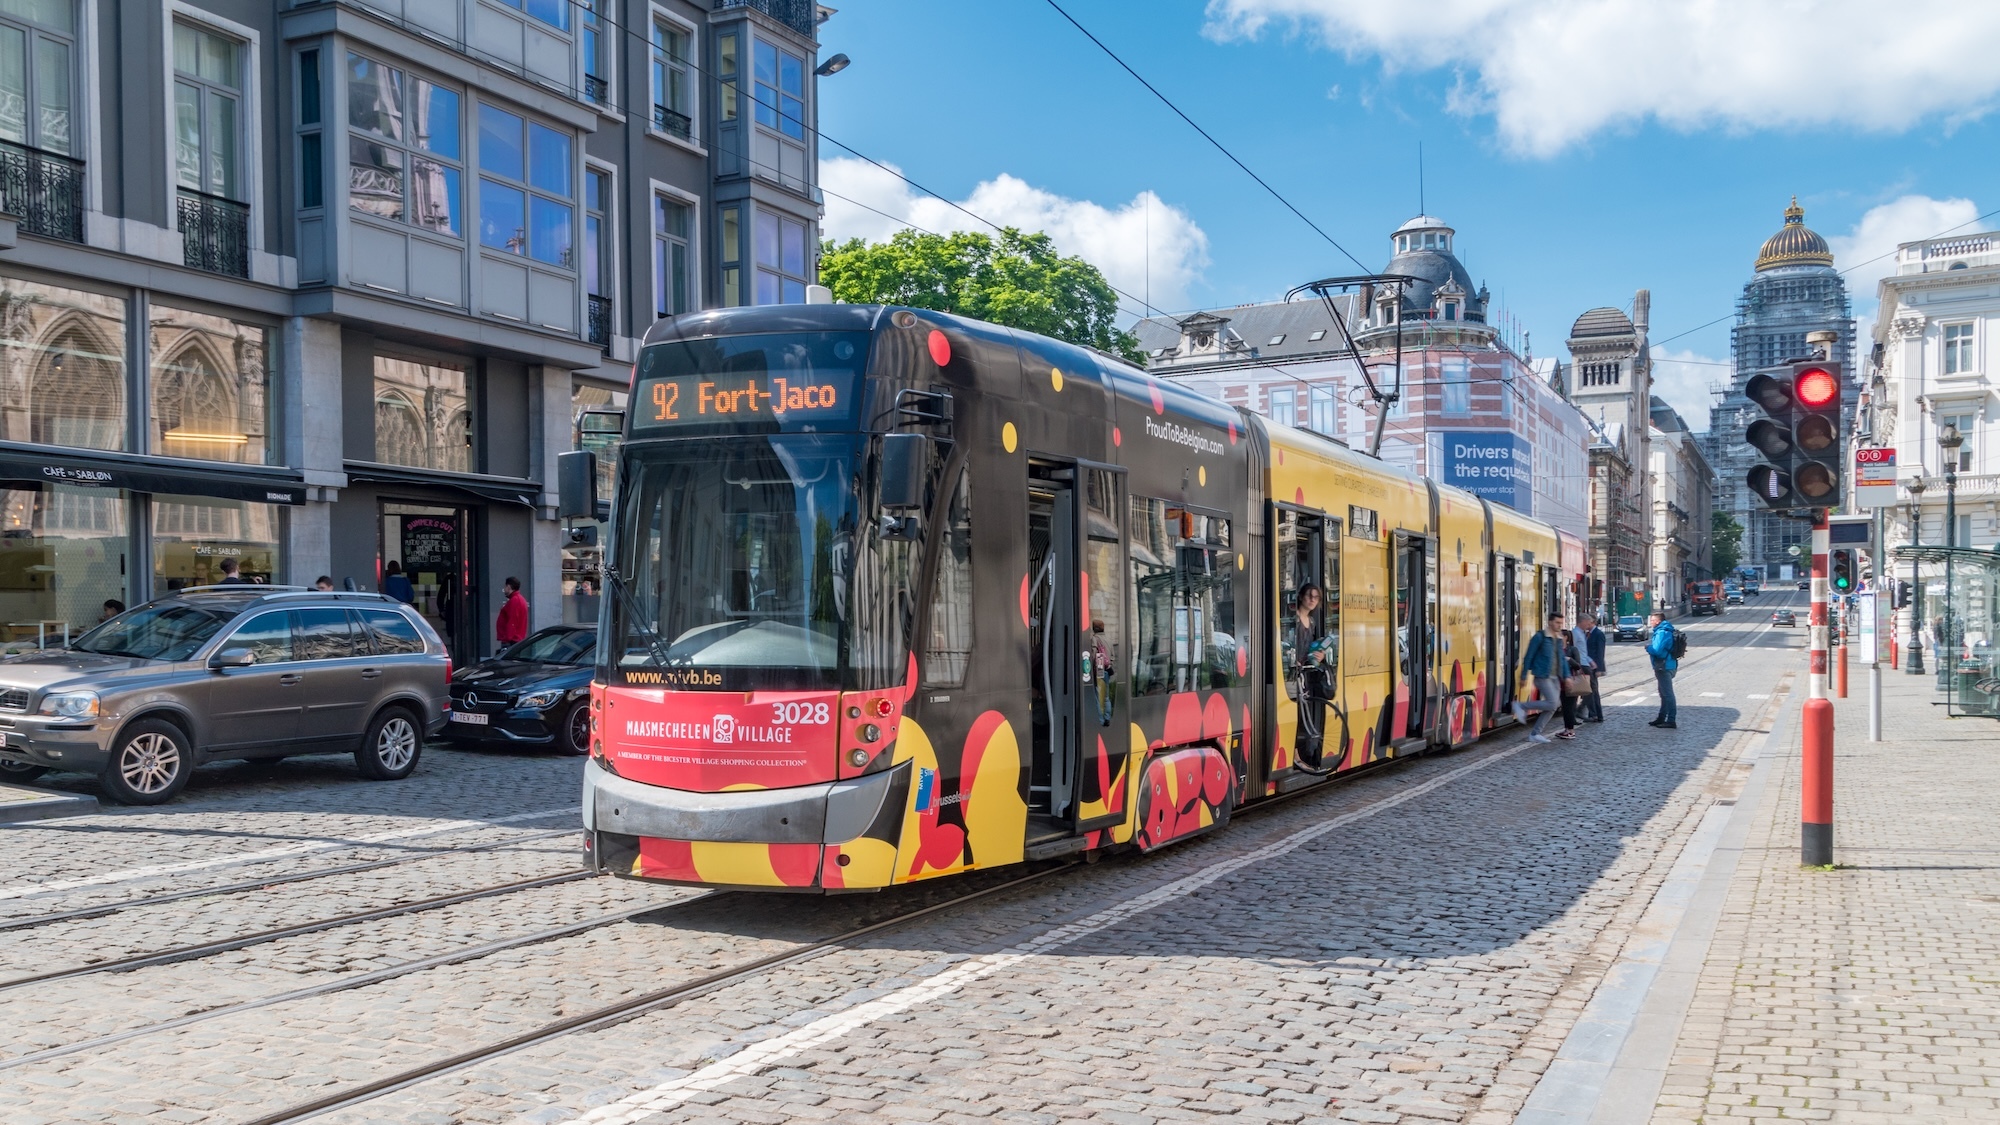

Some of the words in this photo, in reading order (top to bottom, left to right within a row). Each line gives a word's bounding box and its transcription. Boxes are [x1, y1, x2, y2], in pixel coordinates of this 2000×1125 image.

[653, 382, 679, 420] 92
[698, 377, 836, 414] Fort-Jaco
[1145, 415, 1225, 456] ProudToBeBelgian.com
[1454, 444, 1509, 459] Drivers
[1454, 462, 1480, 478] the
[771, 702, 830, 725] 3028
[626, 720, 711, 740] MAASMECHELEN
[737, 727, 792, 743] VILLAGE
[621, 751, 642, 759] MEMBER
[651, 754, 662, 762] THE
[663, 755, 691, 764] BICESTER
[691, 757, 719, 765] VILLAGE
[720, 758, 755, 766] SHOPPING
